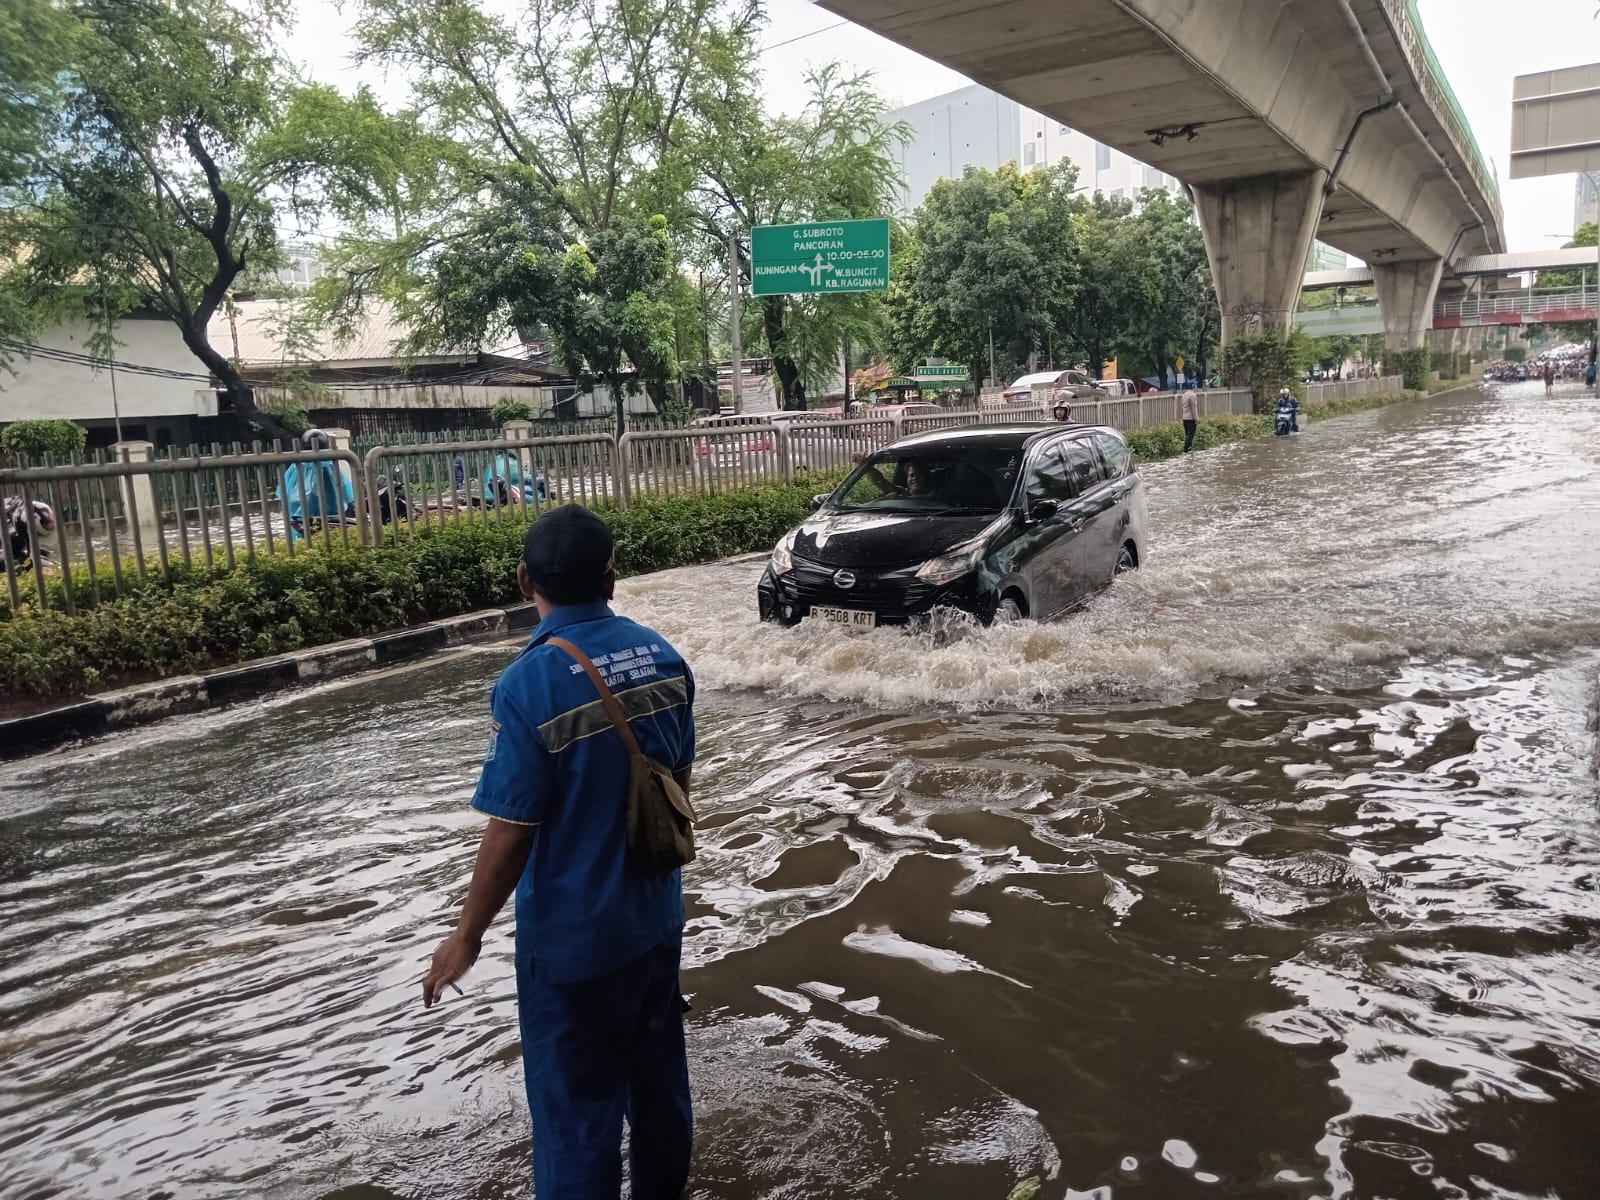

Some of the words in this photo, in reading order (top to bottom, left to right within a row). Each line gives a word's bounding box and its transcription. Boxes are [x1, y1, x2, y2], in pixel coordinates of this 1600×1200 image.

[793, 240, 844, 251] PANCORAN
[755, 264, 797, 275] KUNINGAN
[853, 611, 873, 626] KRT
[629, 665, 657, 680] SELATAN
